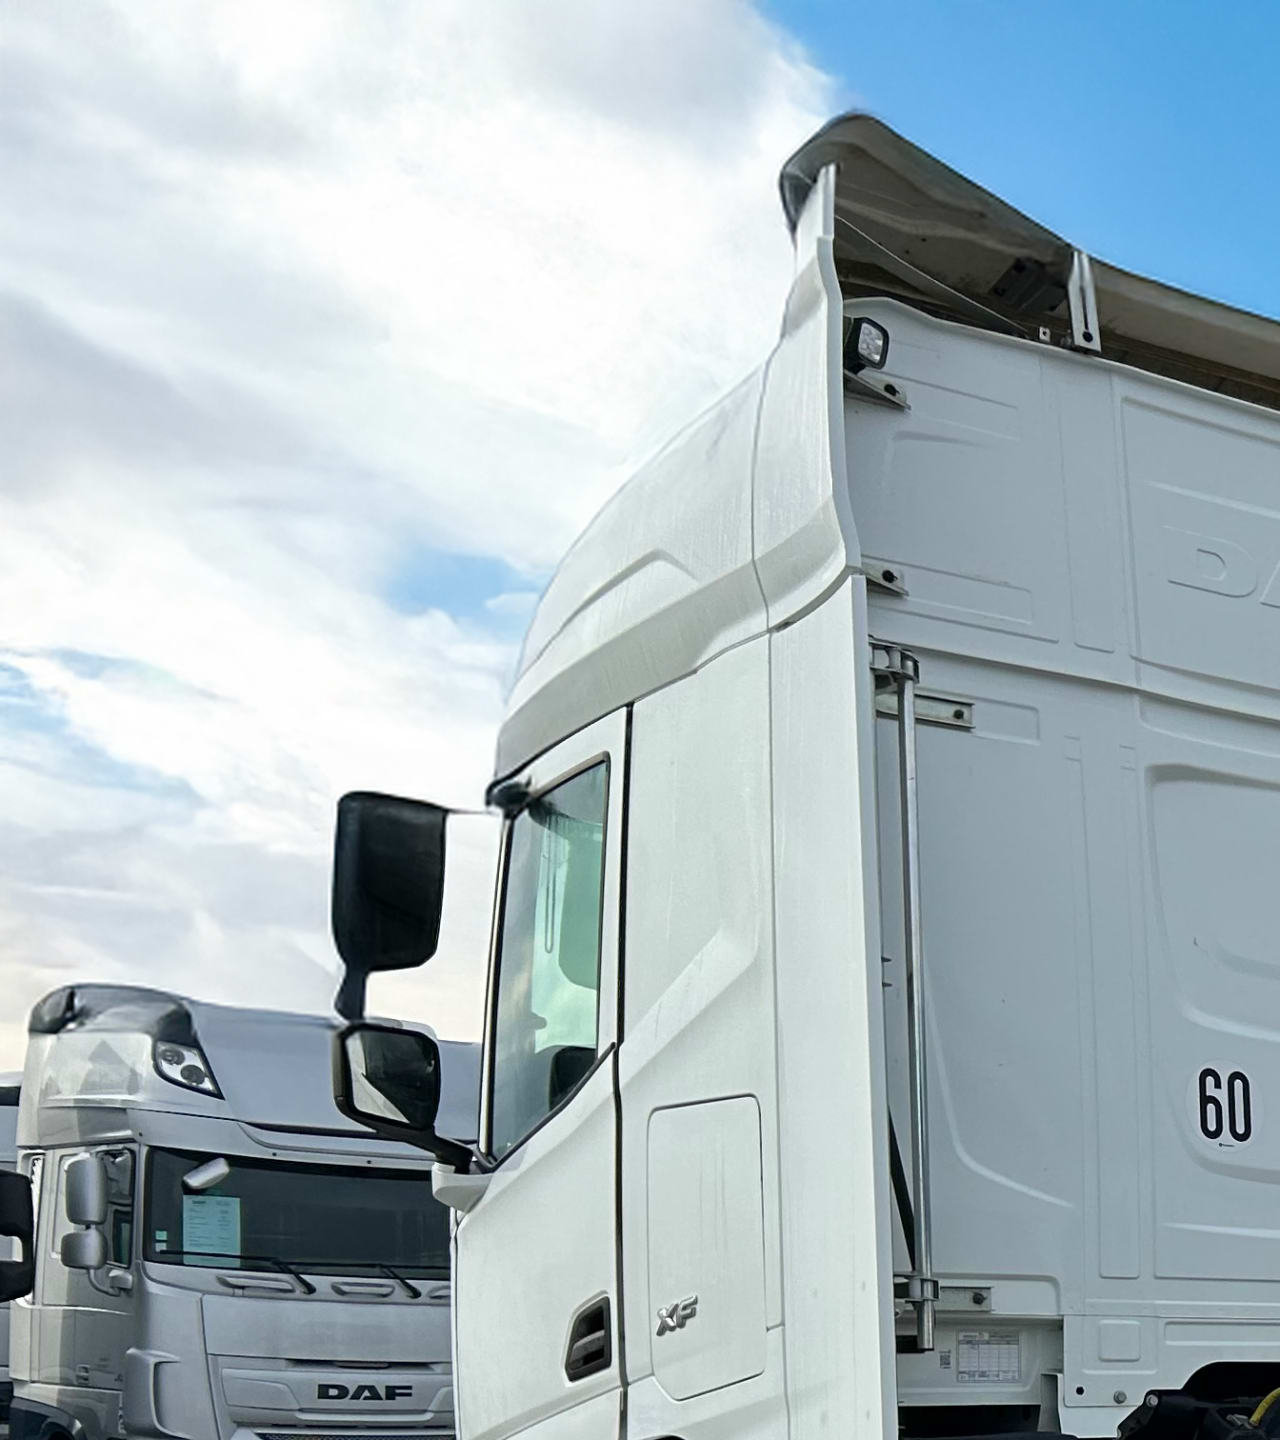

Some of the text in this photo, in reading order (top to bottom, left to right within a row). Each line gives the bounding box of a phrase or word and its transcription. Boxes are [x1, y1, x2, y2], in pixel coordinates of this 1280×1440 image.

[1199, 1067, 1252, 1143] 60
[656, 1294, 698, 1337] XF
[317, 1383, 413, 1401] DAF
